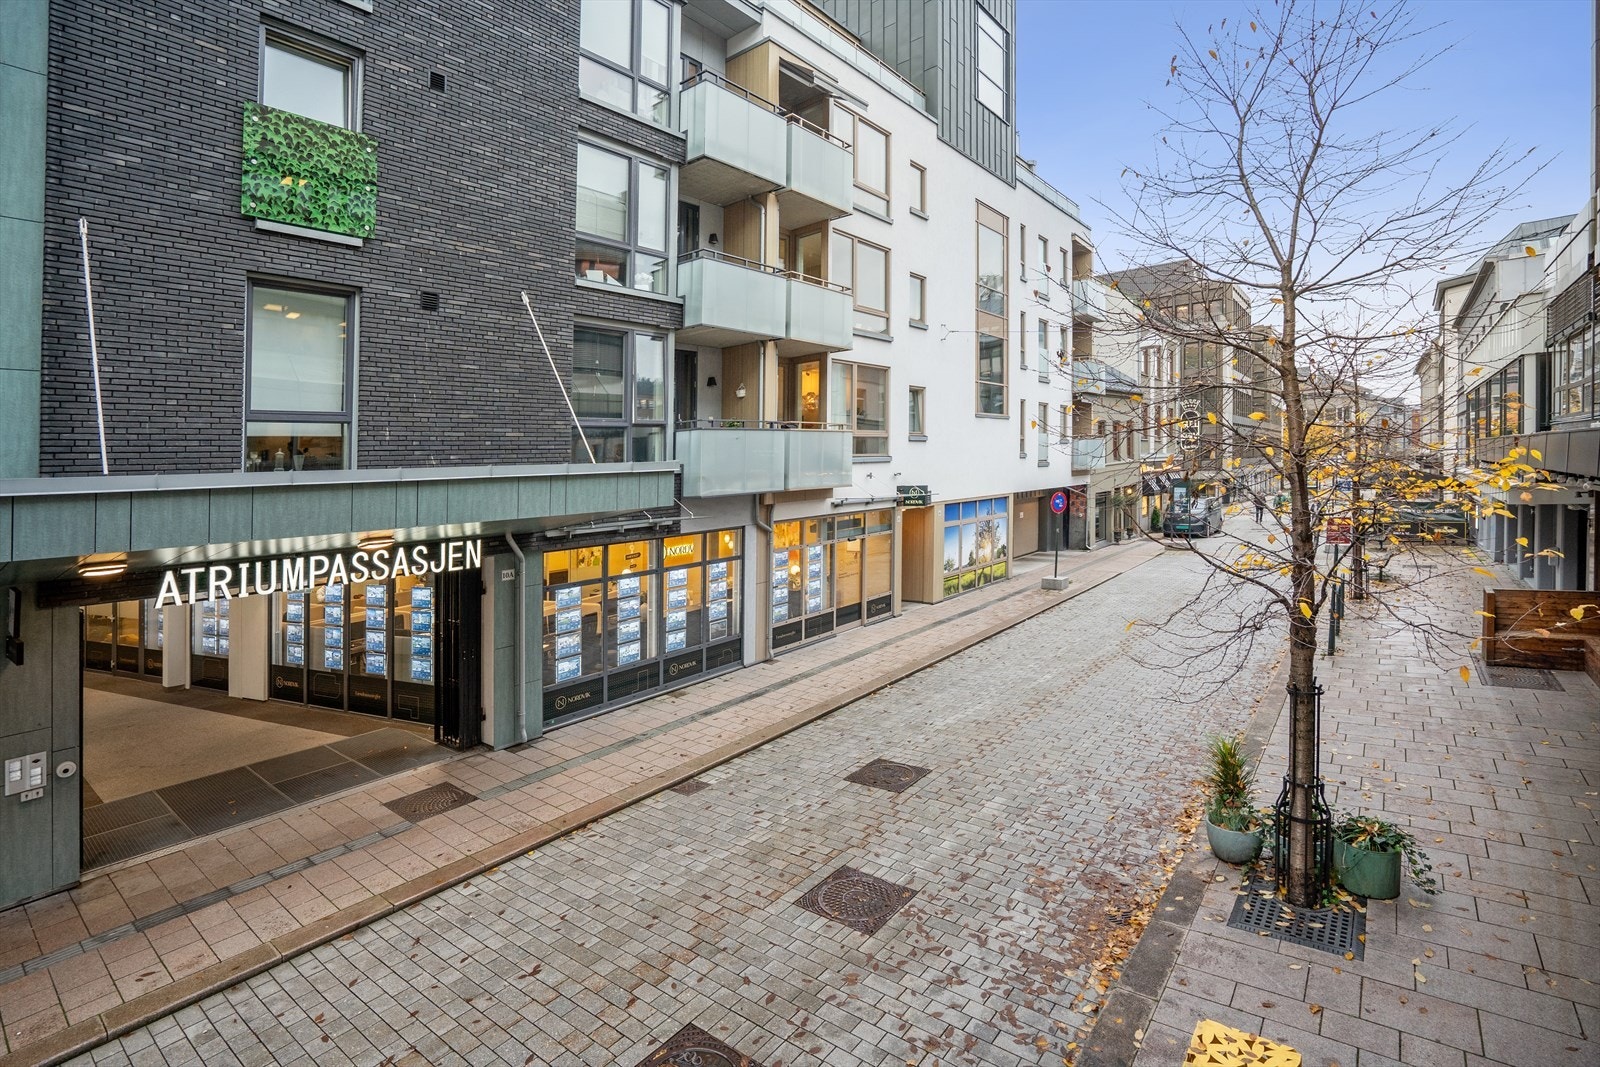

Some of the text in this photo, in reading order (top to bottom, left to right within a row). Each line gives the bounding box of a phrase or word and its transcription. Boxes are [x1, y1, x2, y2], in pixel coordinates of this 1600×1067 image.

[154, 538, 482, 609] ATRIUMPASSASJEN
[678, 660, 697, 670] NORDVIK
[568, 692, 591, 704] NORDVIK
